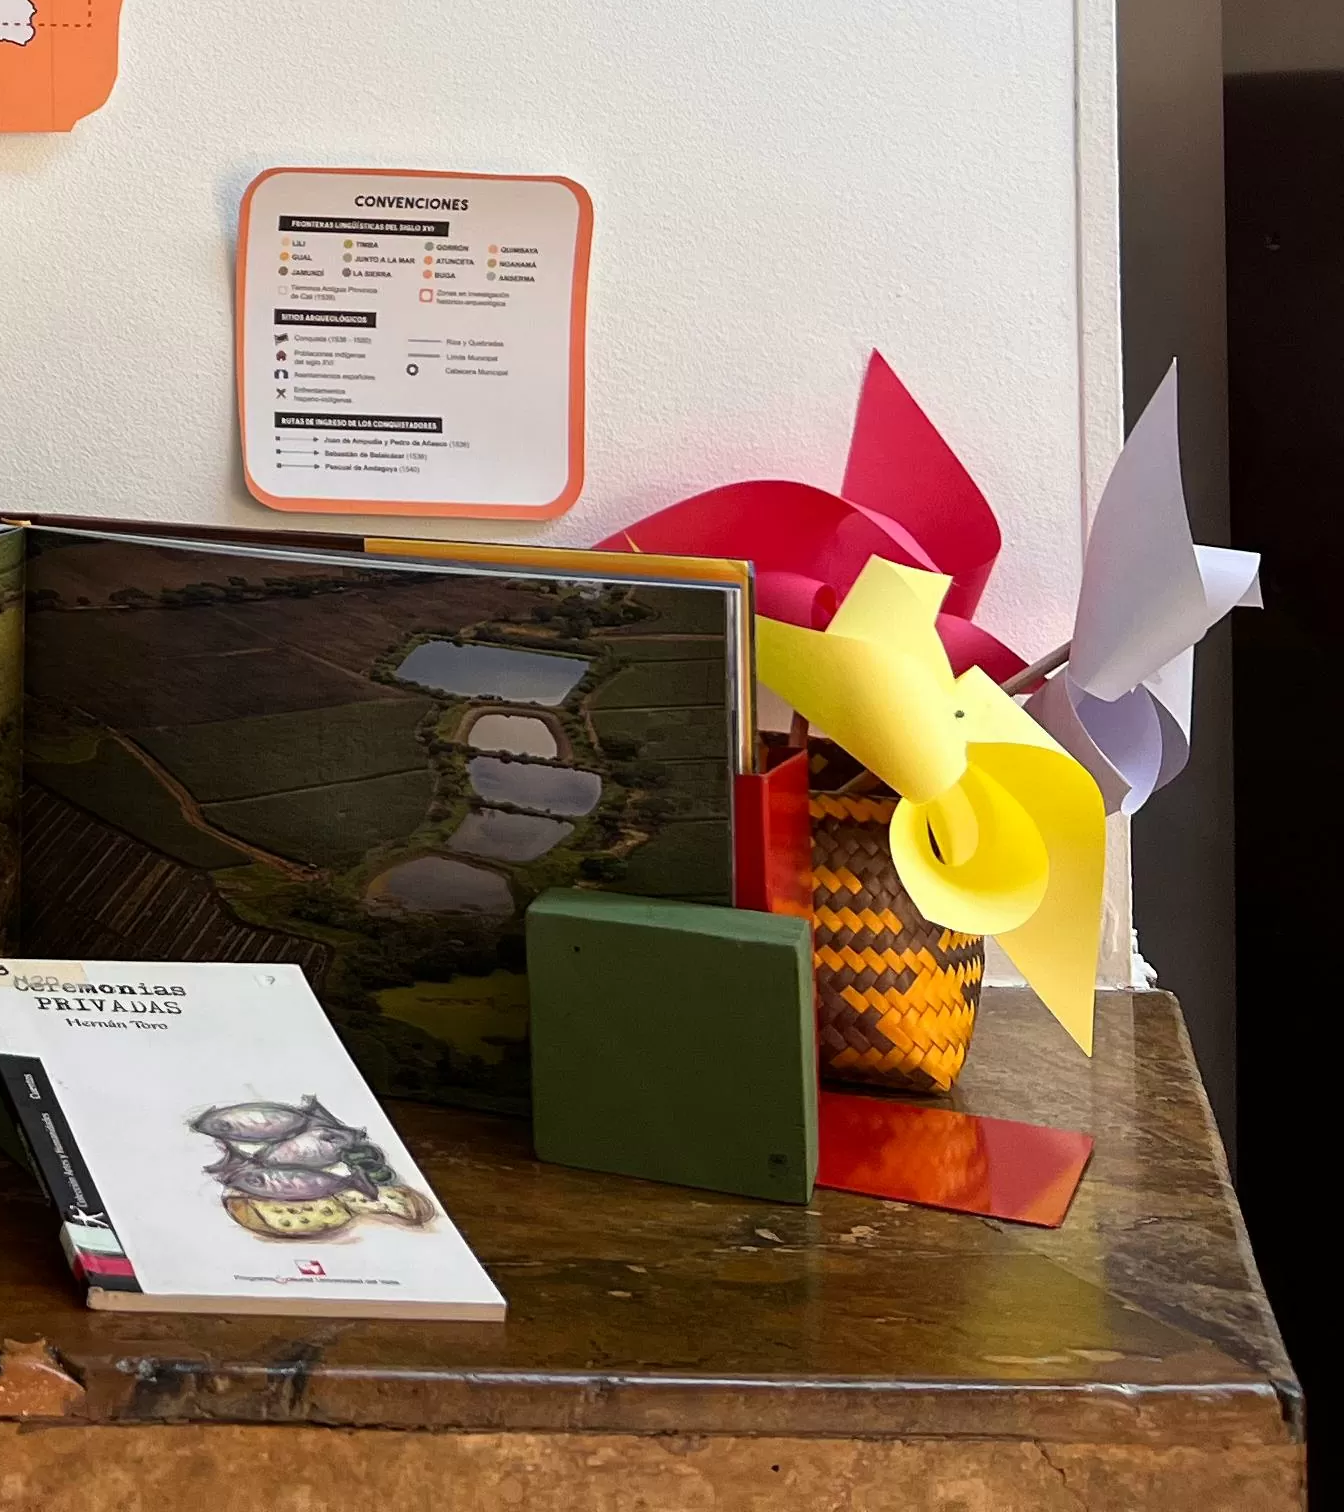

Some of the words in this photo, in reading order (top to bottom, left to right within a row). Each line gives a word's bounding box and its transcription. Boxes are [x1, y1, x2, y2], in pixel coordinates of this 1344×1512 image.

[355, 195, 470, 211] CONVENCIONES
[33, 996, 183, 1016] PRIVADAS
[65, 1016, 128, 1030] Hernán
[129, 1019, 169, 1031] Toro
